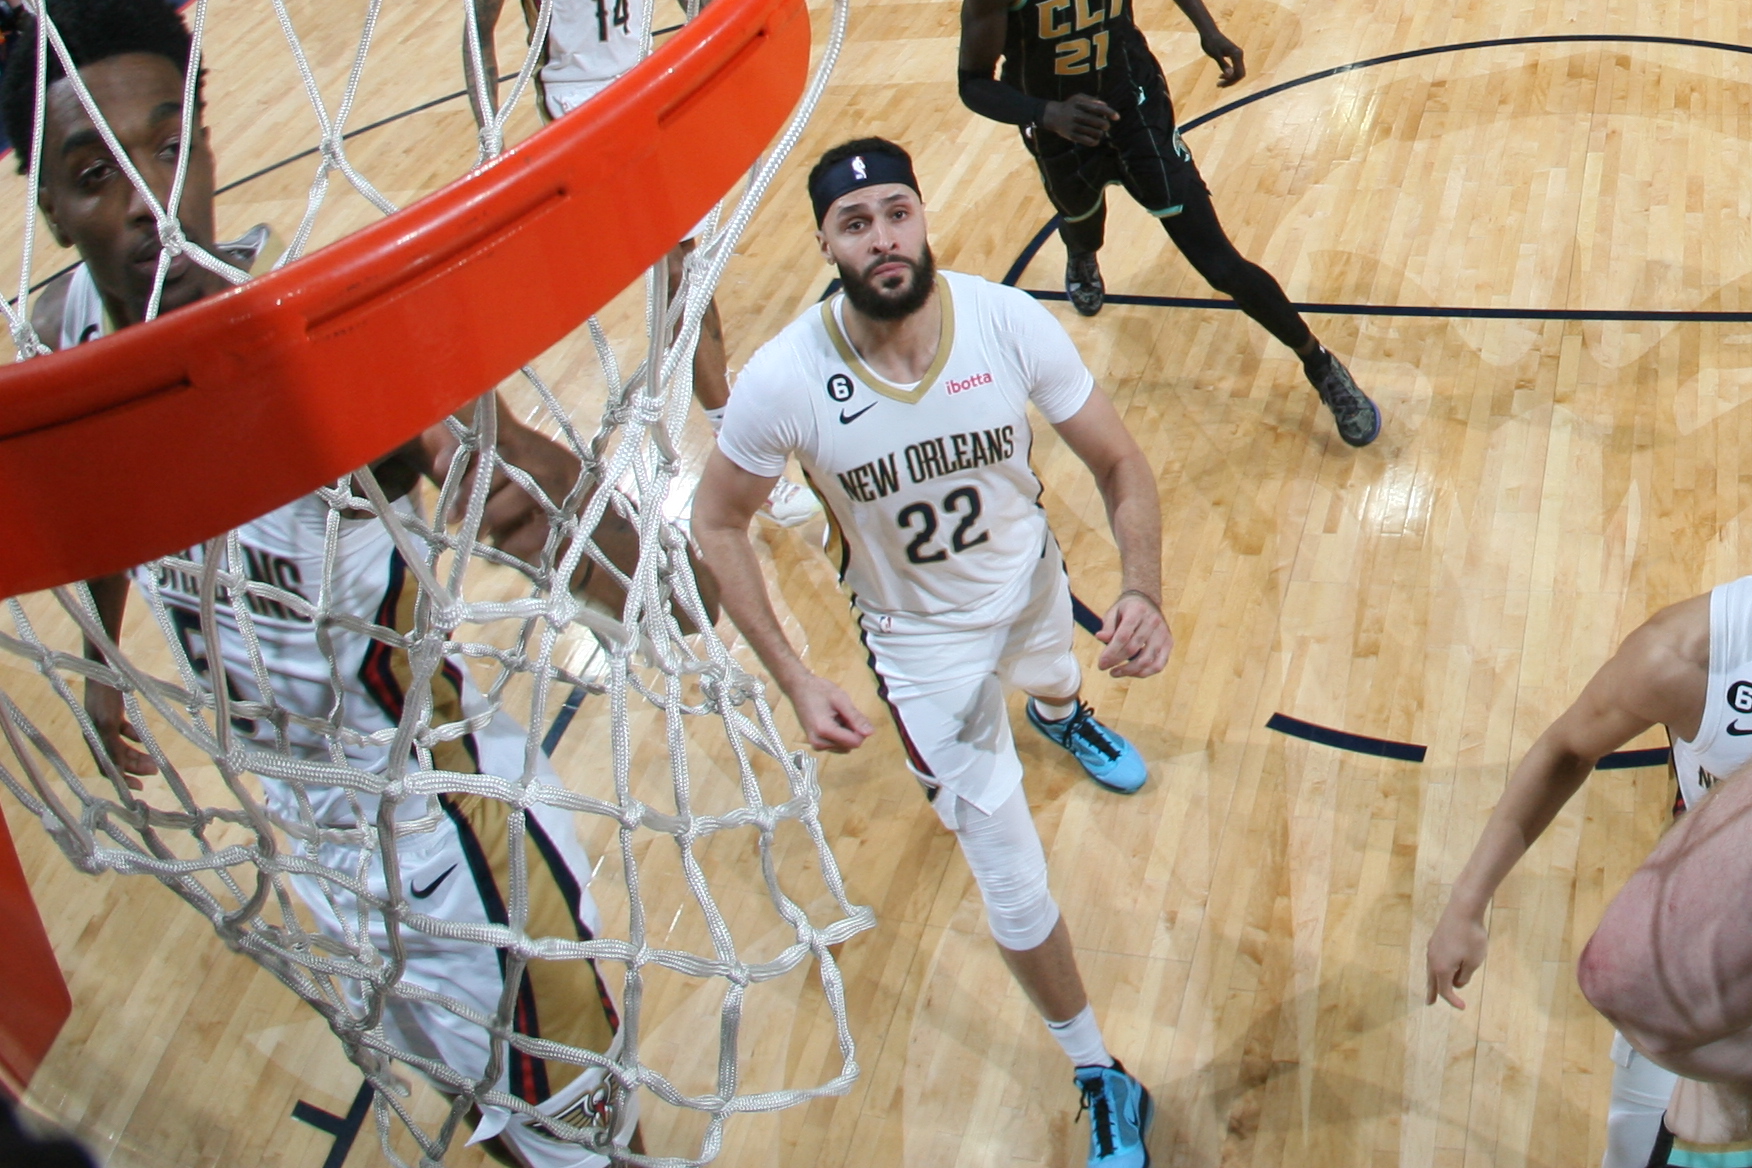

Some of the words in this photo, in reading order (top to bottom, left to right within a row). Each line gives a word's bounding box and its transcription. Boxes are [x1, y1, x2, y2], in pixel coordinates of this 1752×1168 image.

[1054, 30, 1110, 76] 21
[945, 370, 993, 396] ibotta
[837, 450, 899, 505] NEW
[904, 424, 1015, 486] ORLEANS
[897, 485, 990, 565] 22
